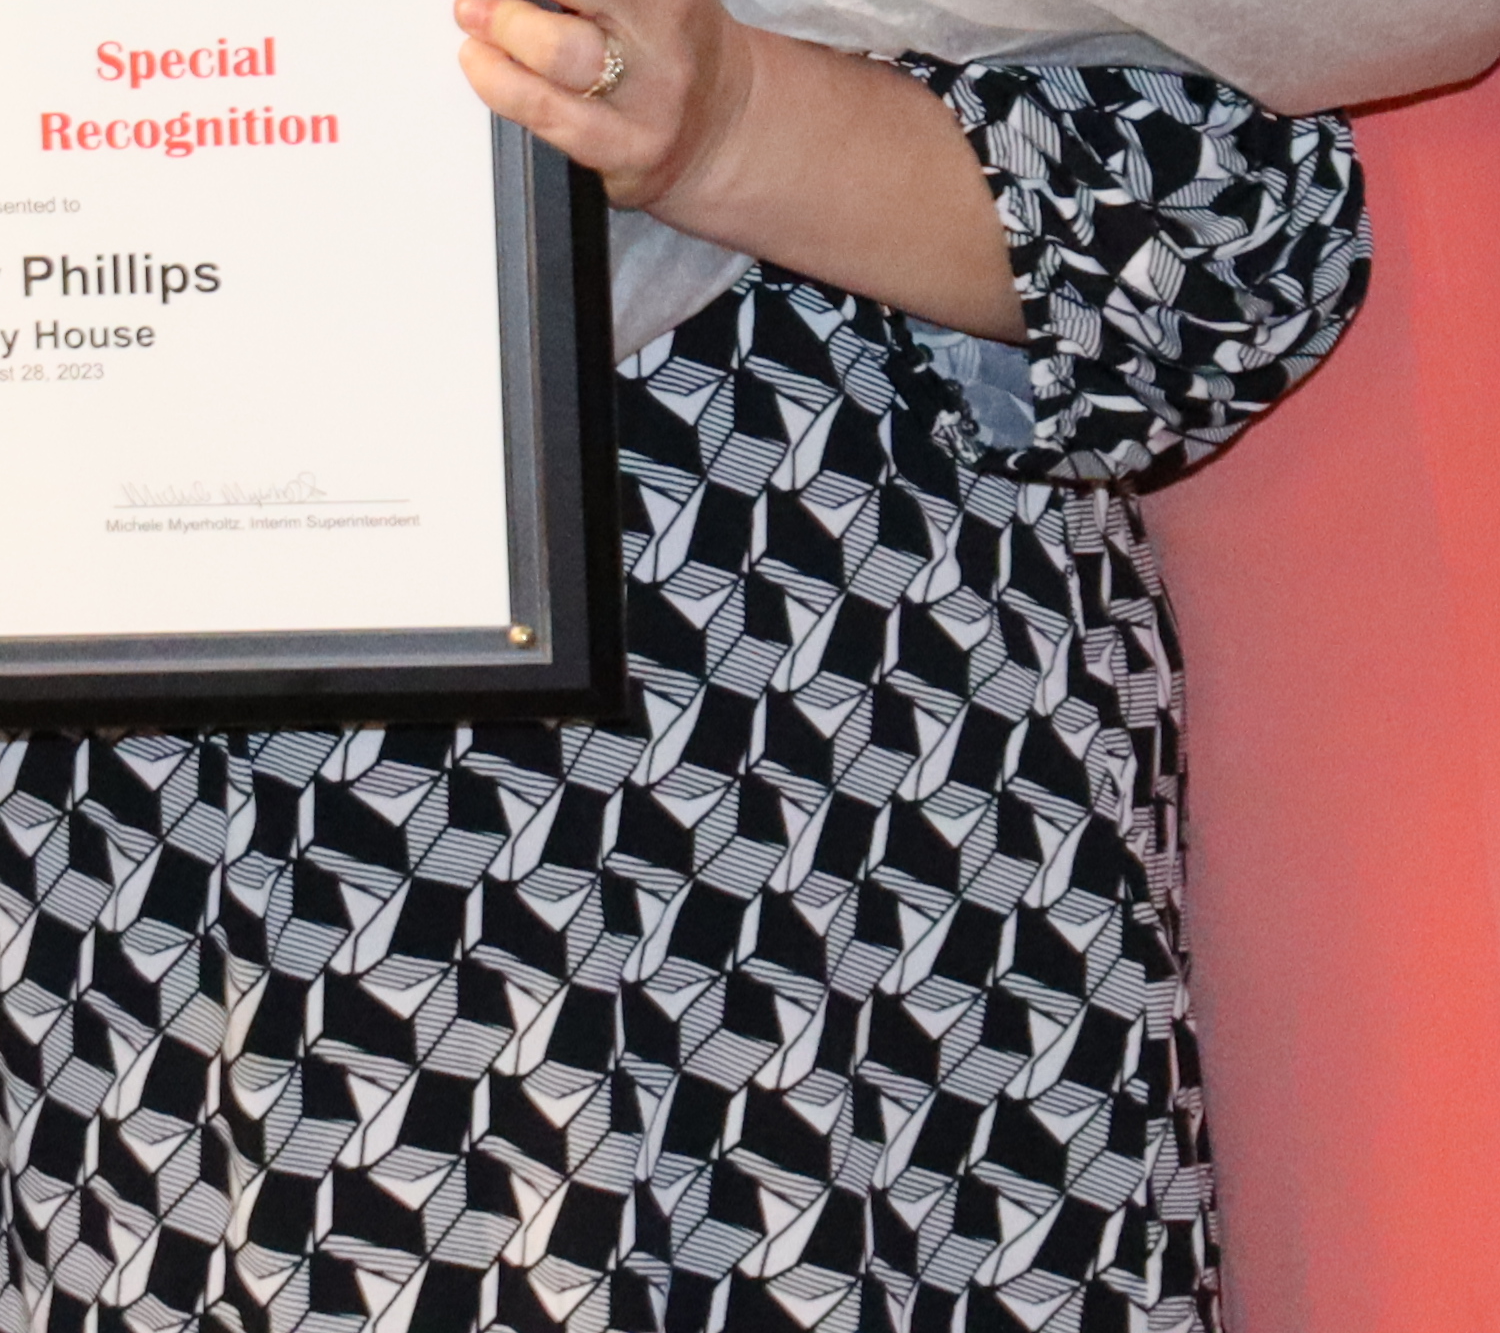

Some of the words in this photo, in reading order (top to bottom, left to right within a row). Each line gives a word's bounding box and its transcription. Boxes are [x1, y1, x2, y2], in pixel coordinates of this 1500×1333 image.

[96, 36, 277, 90] Special
[40, 106, 340, 158] Recognition
[63, 197, 82, 214] to
[21, 252, 223, 306] Phillips
[34, 319, 156, 351] House
[57, 362, 105, 382] 2023
[105, 517, 164, 533] Michele
[250, 515, 302, 530] Interim
[306, 513, 421, 532] Superintendent
